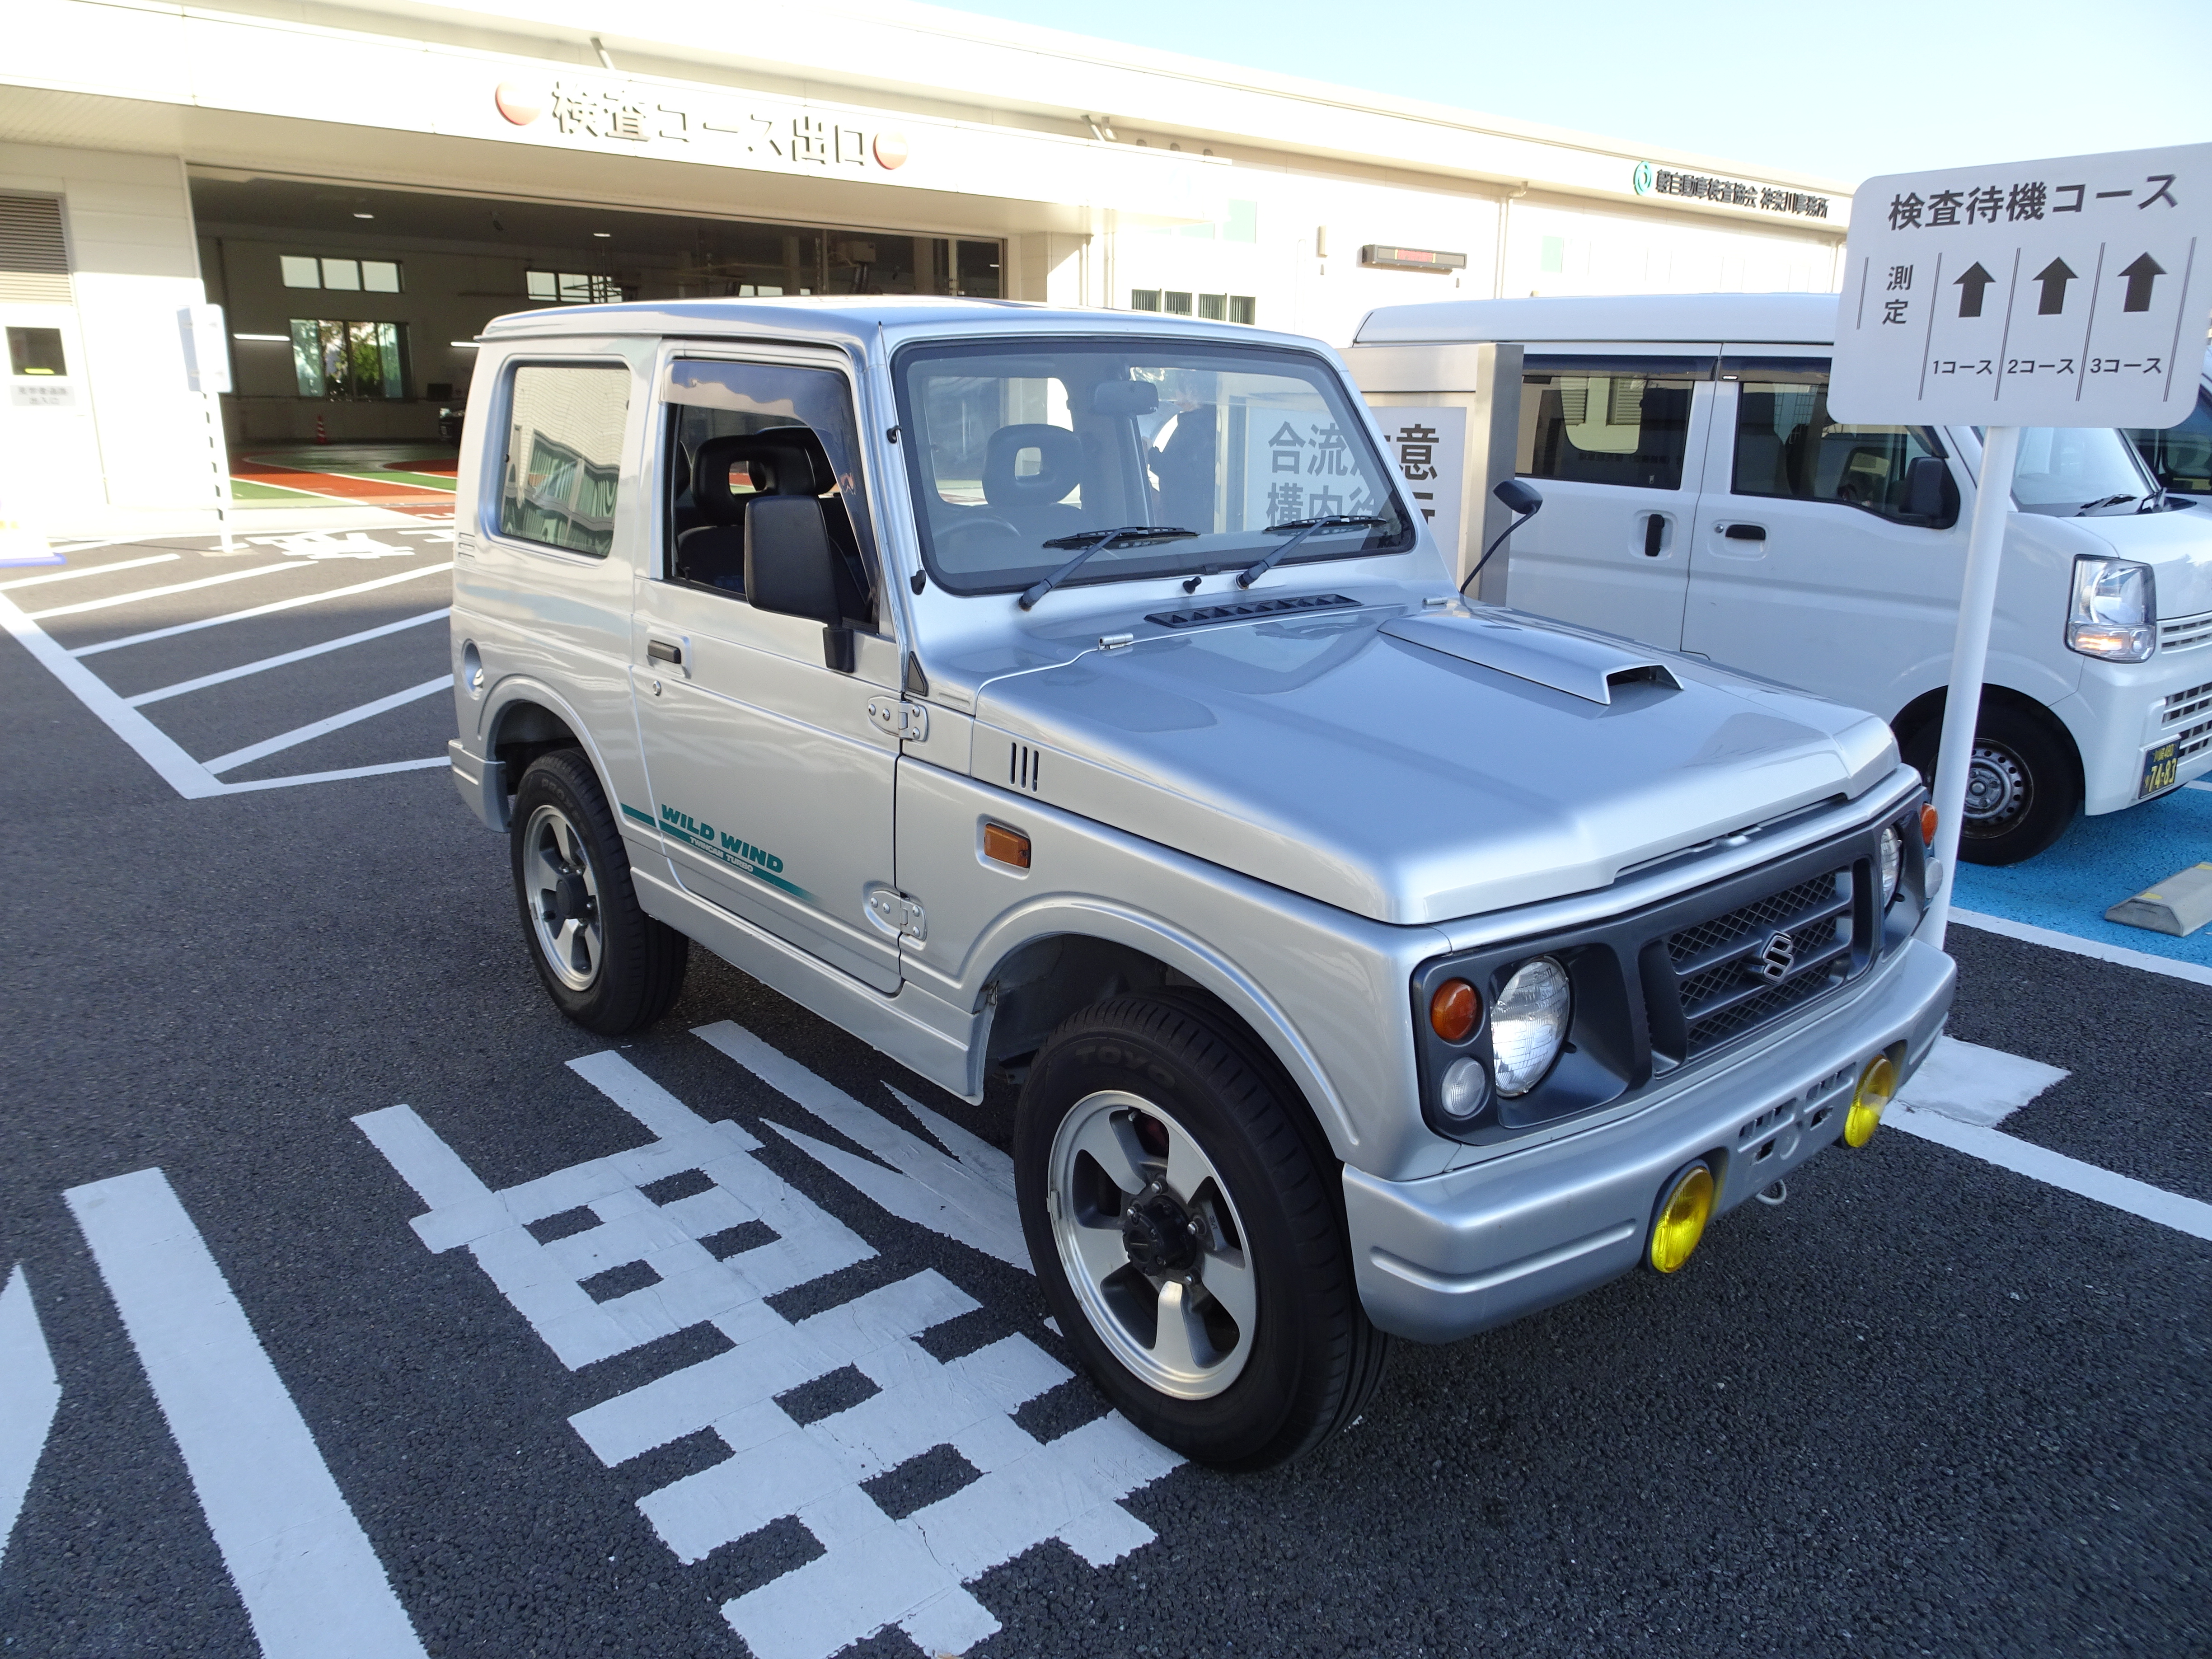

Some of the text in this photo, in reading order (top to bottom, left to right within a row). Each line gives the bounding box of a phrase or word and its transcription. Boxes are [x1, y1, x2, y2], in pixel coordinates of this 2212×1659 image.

[551, 80, 866, 166] 検査コース出口
[1760, 187, 1830, 219] 神奈川事務所
[1887, 173, 2178, 231] 検査待機コース
[1882, 264, 1913, 325] 測定
[1933, 360, 1993, 375] 1コース
[2007, 359, 2075, 375] 2コース
[2090, 357, 2162, 375] 3コース
[1268, 421, 1439, 481] 合流意
[2148, 758, 2177, 793] 74-83
[661, 804, 784, 874] WILD WIND
[689, 836, 754, 872] TWINCAM TURBO
[1076, 1045, 1176, 1089] TOYO
